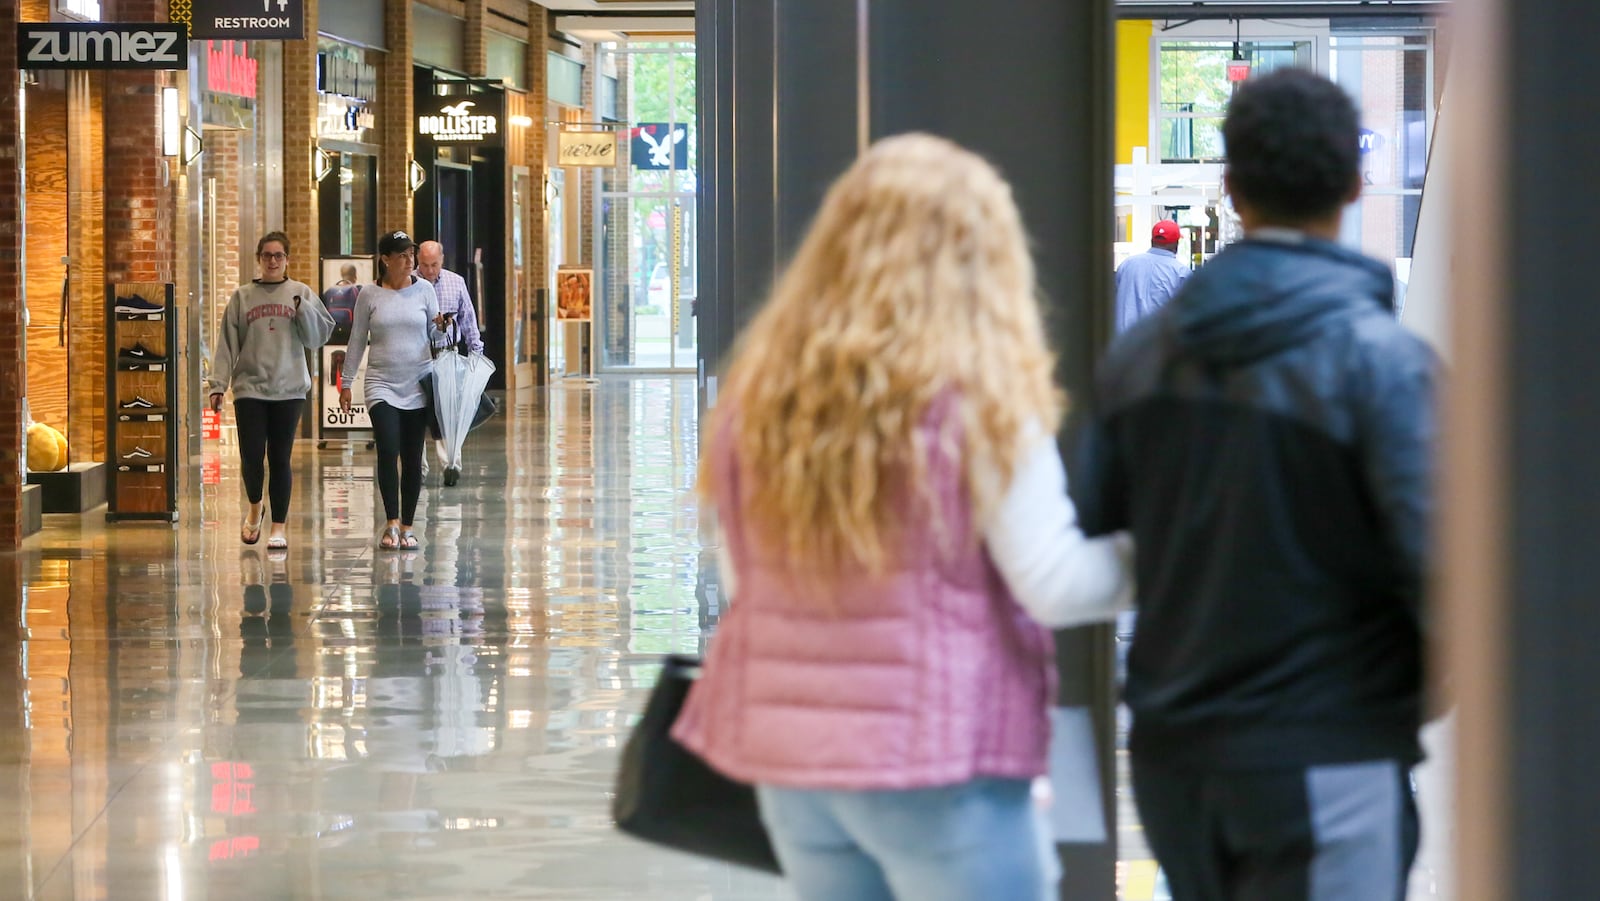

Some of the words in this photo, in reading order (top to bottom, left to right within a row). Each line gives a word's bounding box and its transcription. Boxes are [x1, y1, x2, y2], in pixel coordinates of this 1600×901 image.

[214, 17, 290, 28] RESTROOM
[27, 30, 178, 62] zumiez
[419, 115, 497, 134] HOLLISTER
[328, 413, 355, 424] OUT
